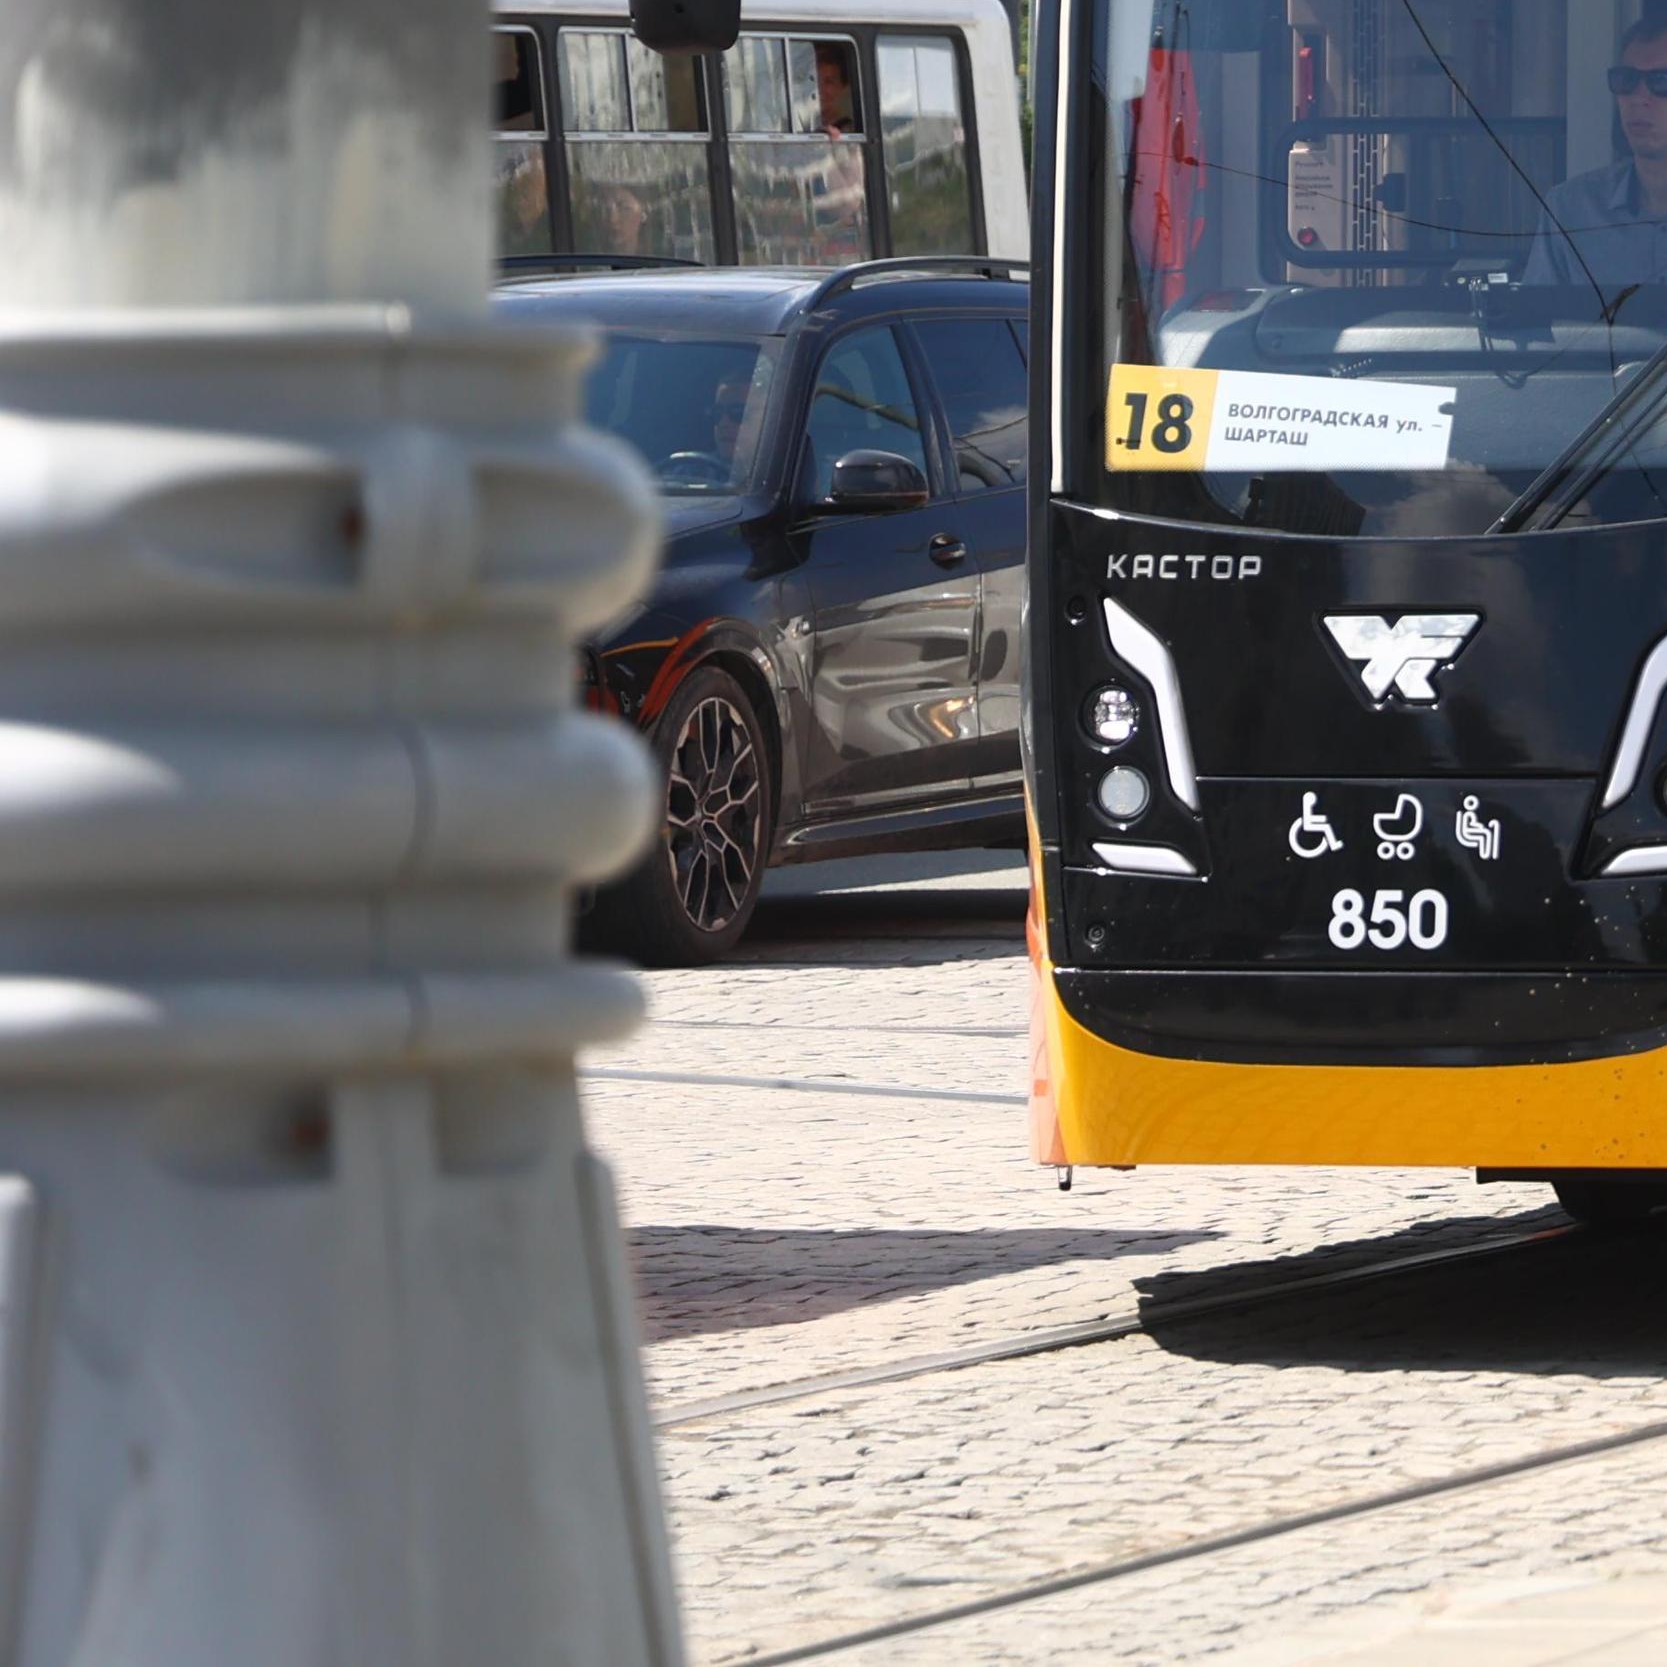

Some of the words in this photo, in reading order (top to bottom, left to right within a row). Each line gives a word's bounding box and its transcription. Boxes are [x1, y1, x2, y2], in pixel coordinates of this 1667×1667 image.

[1122, 392, 1194, 454] 18
[1228, 403, 1389, 429] ВОЛГОГРАДСКАЯ
[1396, 419, 1423, 433] ул.
[1224, 426, 1309, 447] ШАРТАШ
[1107, 553, 1262, 580] КАСТОР
[1328, 888, 1449, 950] 850
